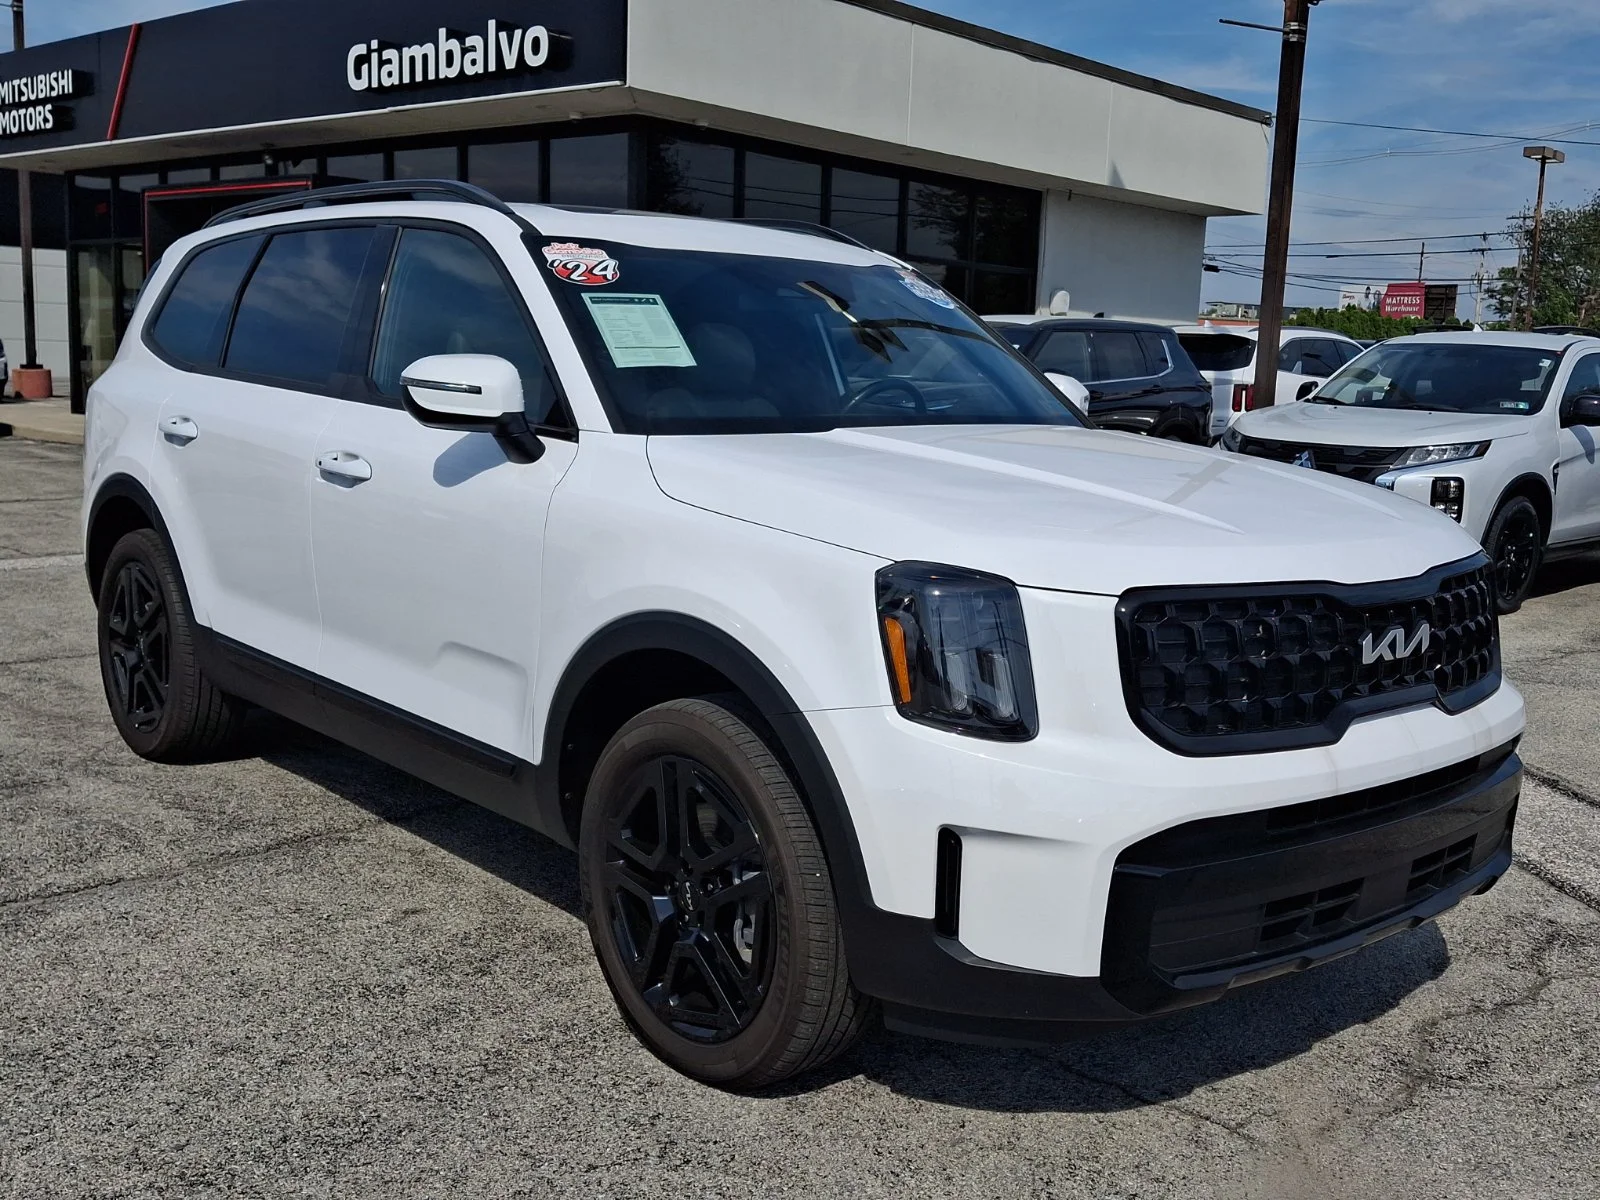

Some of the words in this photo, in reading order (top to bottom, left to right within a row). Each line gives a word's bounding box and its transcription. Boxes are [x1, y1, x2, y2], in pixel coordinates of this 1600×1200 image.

[346, 18, 549, 91] Giambalvo
[0, 68, 73, 105] MITSUBISHI
[0, 103, 54, 135] MOTORS
[1385, 296, 1420, 304] MATTRESS
[1362, 623, 1430, 665] KIA
